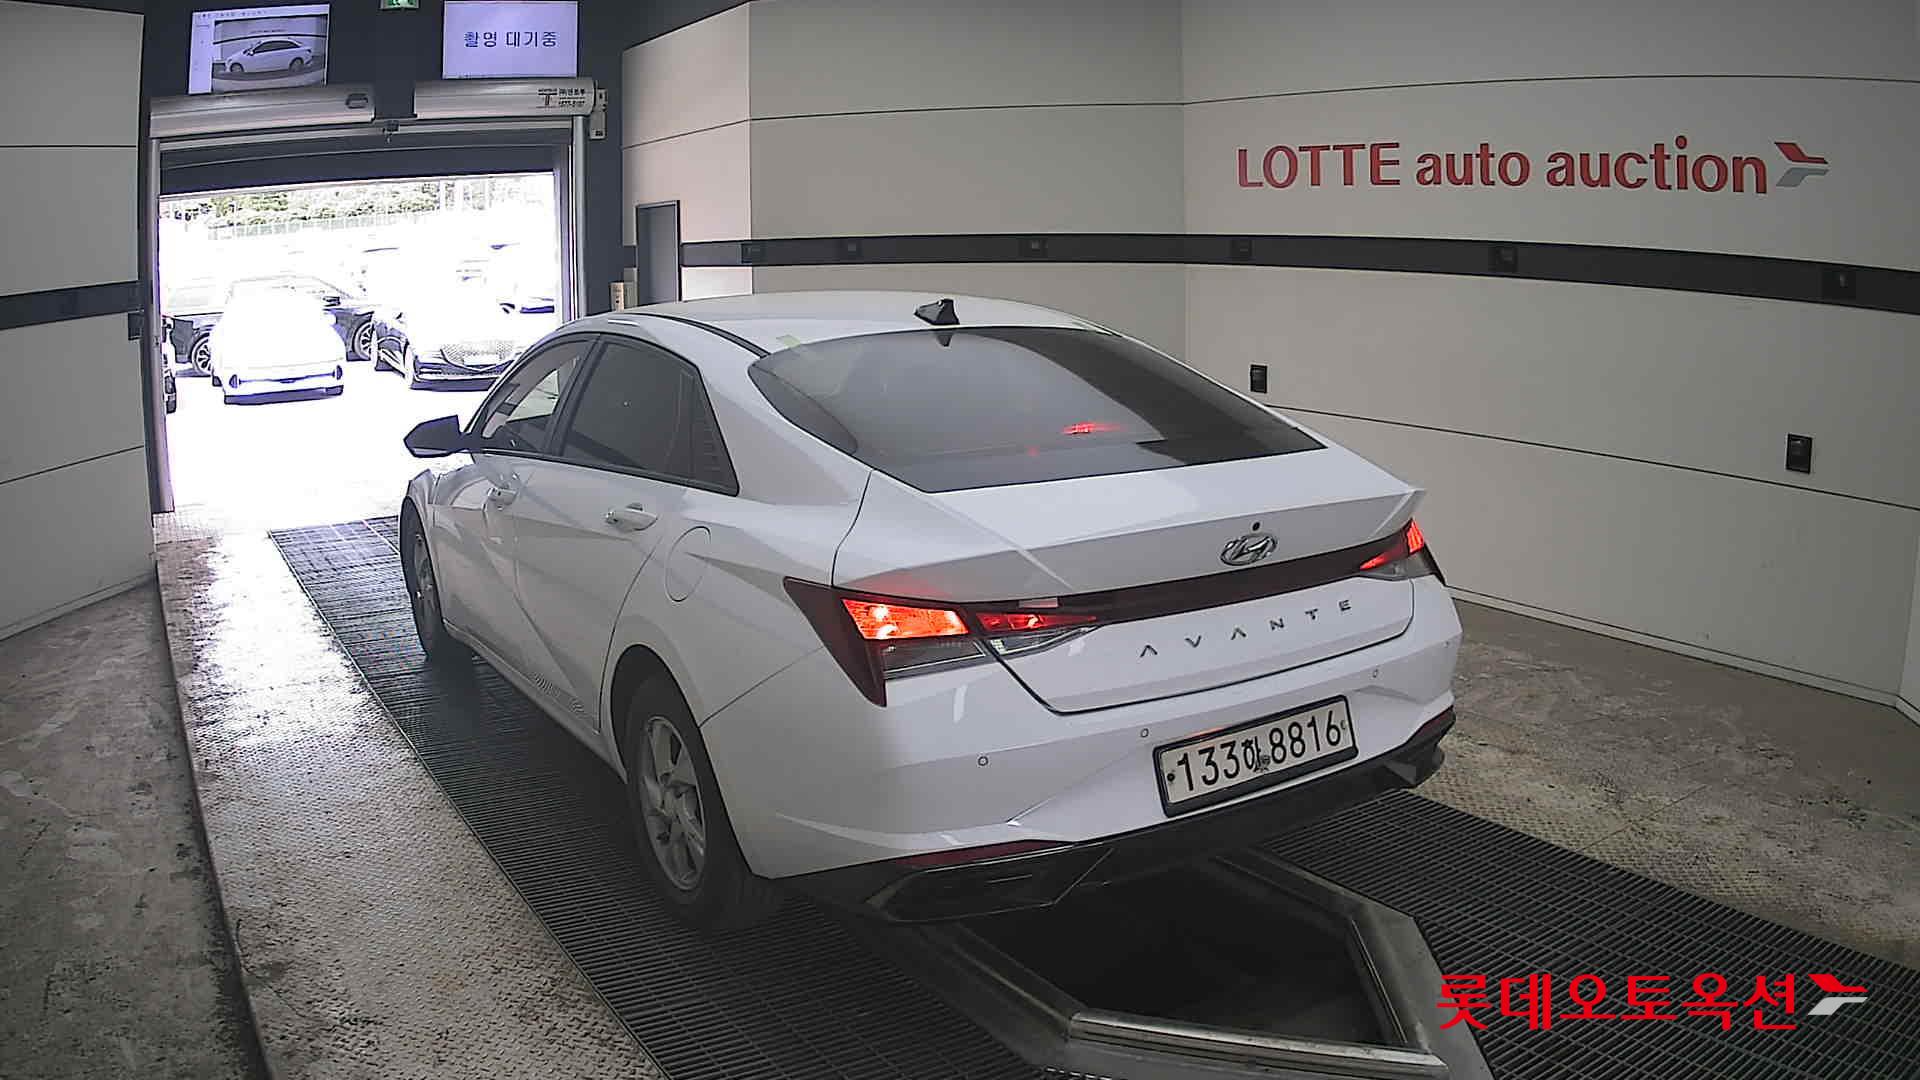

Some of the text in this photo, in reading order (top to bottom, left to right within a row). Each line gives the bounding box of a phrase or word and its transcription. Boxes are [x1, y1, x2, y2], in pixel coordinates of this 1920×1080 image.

[505, 31, 557, 48] 대기중
[1237, 136, 1767, 194] LOTTE auto auction
[1140, 599, 1352, 657] AVANTE
[1177, 709, 1342, 791] 133하8816
